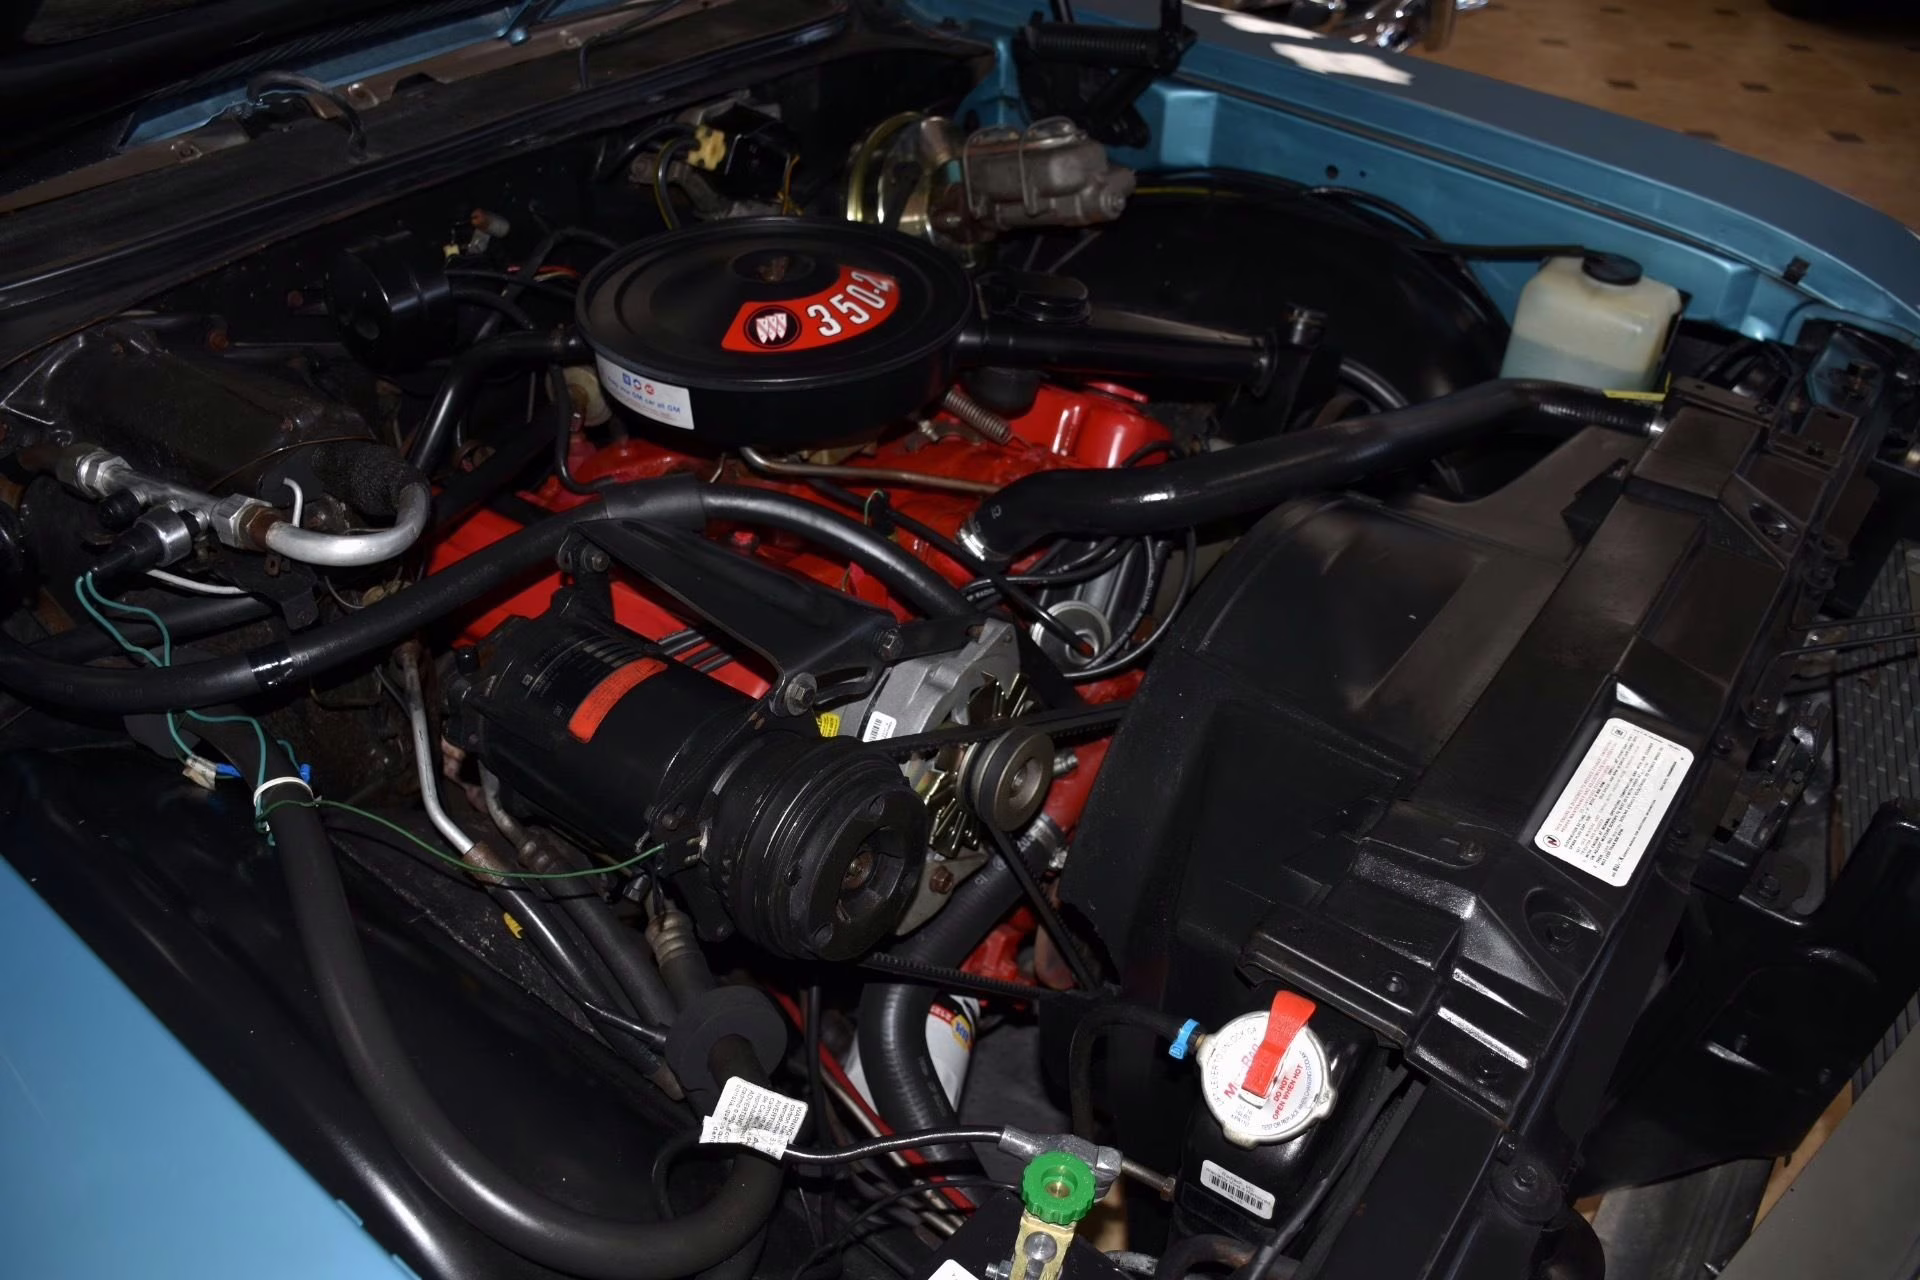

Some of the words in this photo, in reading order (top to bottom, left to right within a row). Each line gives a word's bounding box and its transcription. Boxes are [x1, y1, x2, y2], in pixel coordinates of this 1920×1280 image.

[666, 404, 681, 413] GM
[1271, 1100, 1286, 1120] OPEN
[1281, 1078, 1297, 1100] WHEN
[1292, 1063, 1304, 1079] HOT
[1277, 1075, 1290, 1090] NOT
[1272, 1089, 1283, 1102] DO
[1280, 1108, 1299, 1125] REPLACE
[1295, 1094, 1309, 1110] WHEN
[1303, 1070, 1313, 1097] CHANGING
[788, 1106, 803, 1137] WARNING
